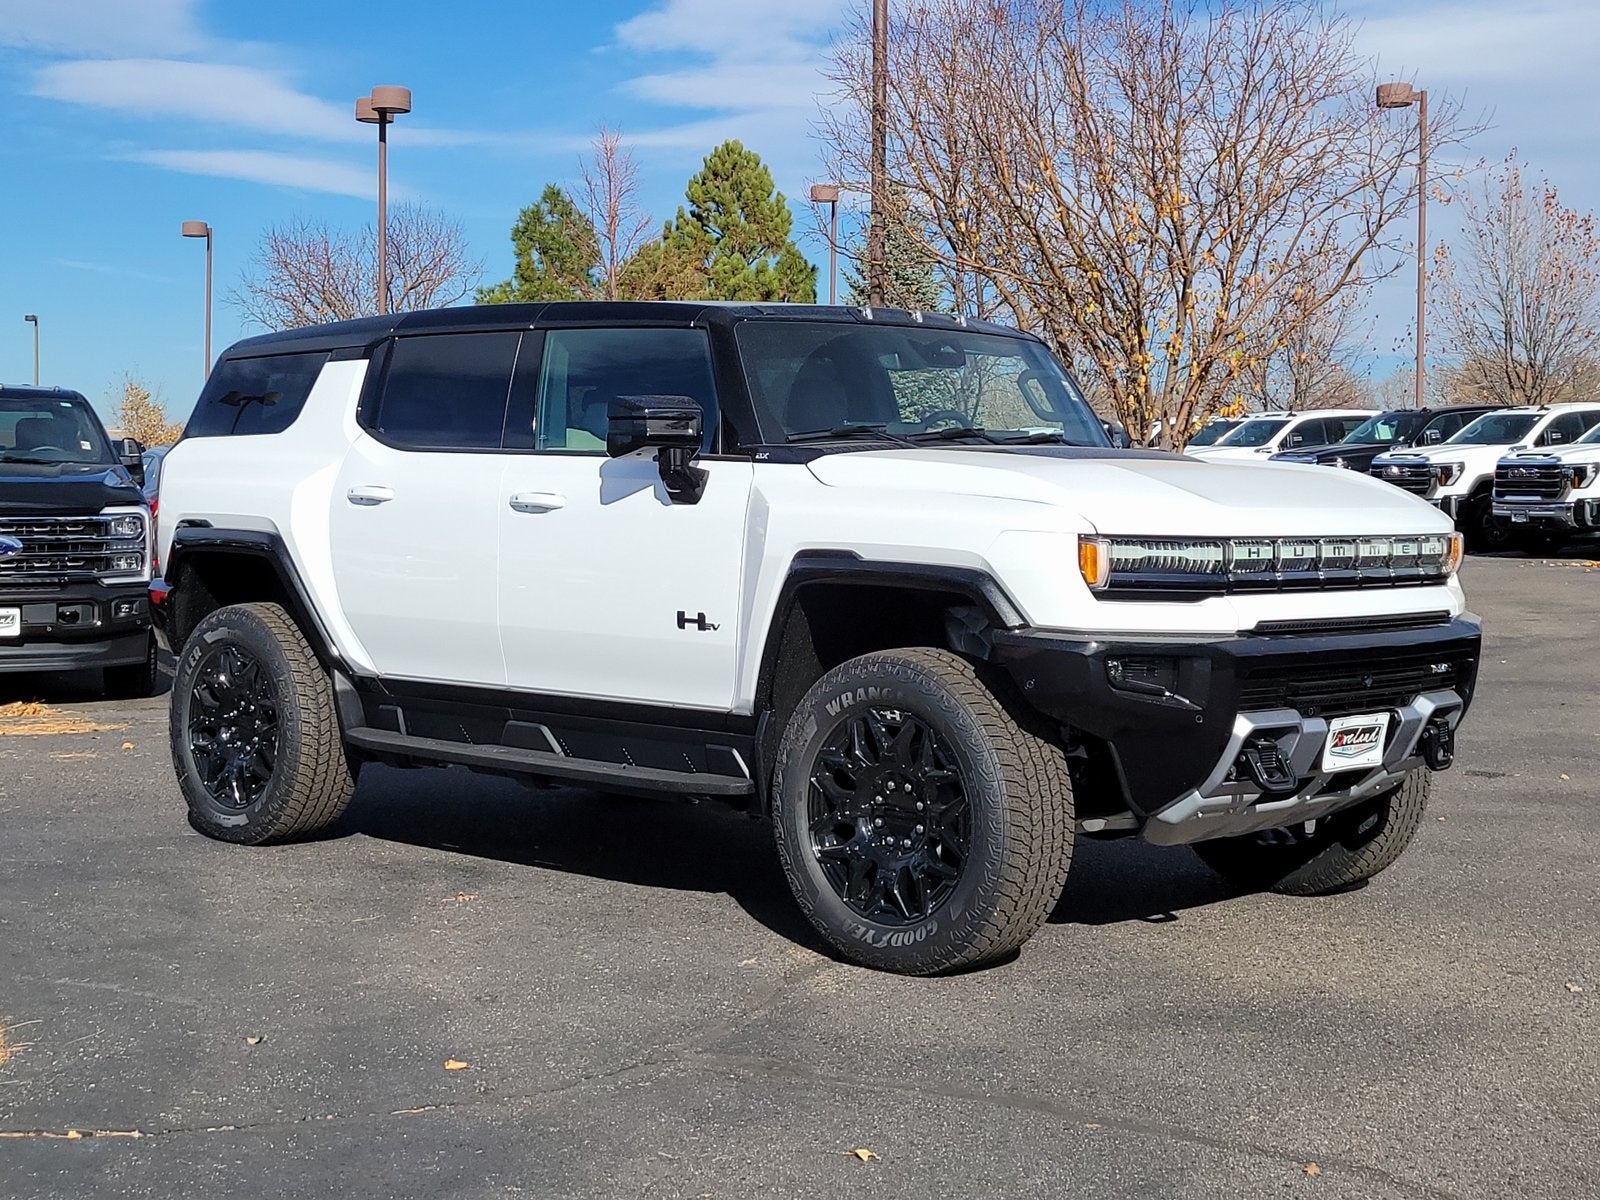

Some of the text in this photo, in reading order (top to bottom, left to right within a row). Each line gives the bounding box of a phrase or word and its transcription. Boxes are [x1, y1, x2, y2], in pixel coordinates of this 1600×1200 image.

[1249, 543, 1441, 558] HUMMER
[825, 686, 895, 717] WRANG
[842, 919, 938, 949] GOODYEA
